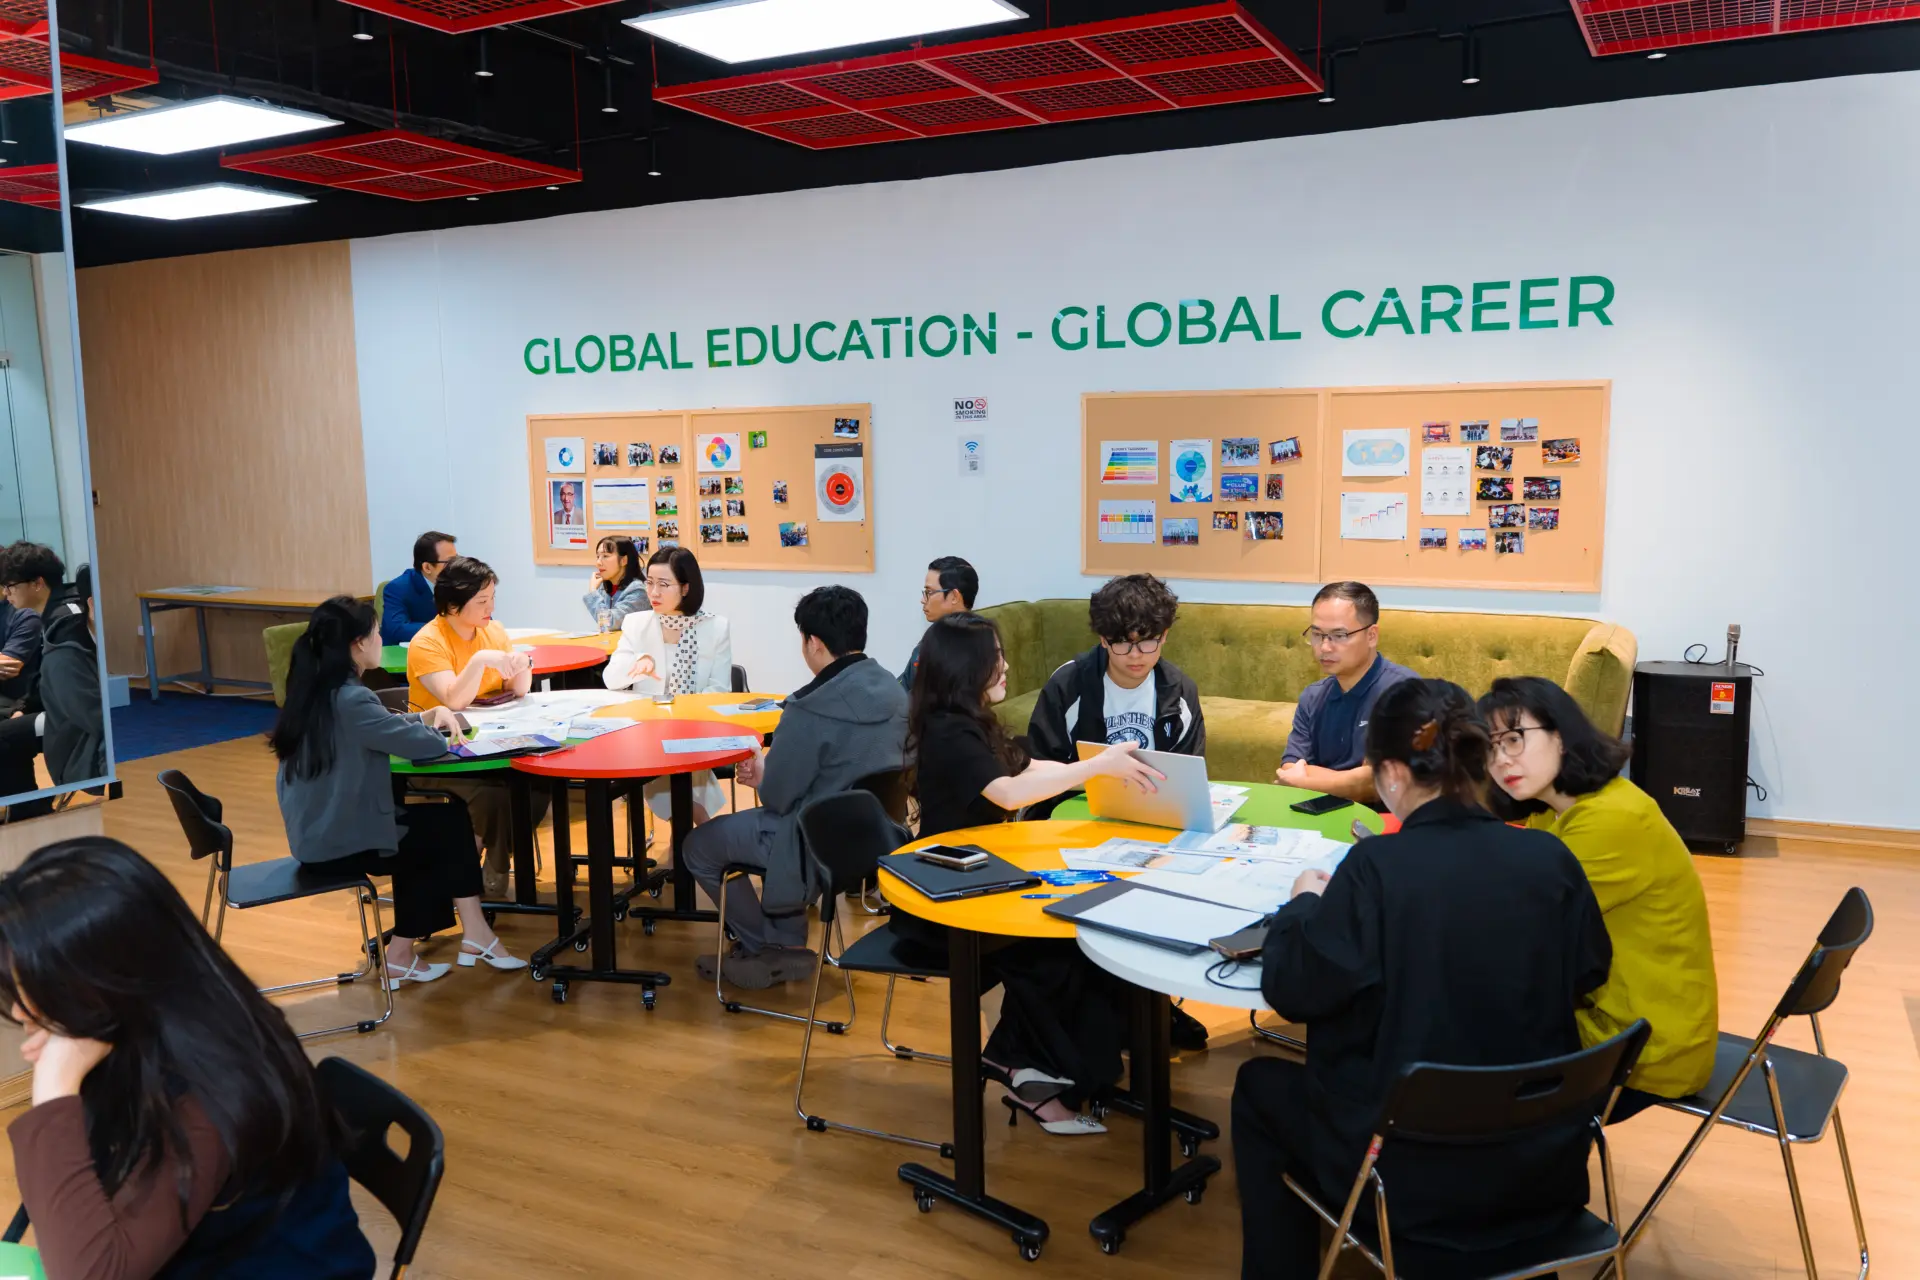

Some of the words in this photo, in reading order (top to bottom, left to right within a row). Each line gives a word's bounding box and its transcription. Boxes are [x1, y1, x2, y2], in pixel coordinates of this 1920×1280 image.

[524, 331, 694, 375] GLOBAL
[706, 311, 997, 368] EDUCATION
[1051, 294, 1302, 351] GLOBAL
[1321, 275, 1615, 339] CAREER
[954, 400, 974, 410] NO
[1117, 713, 1129, 727] IN
[1128, 711, 1148, 727] THE
